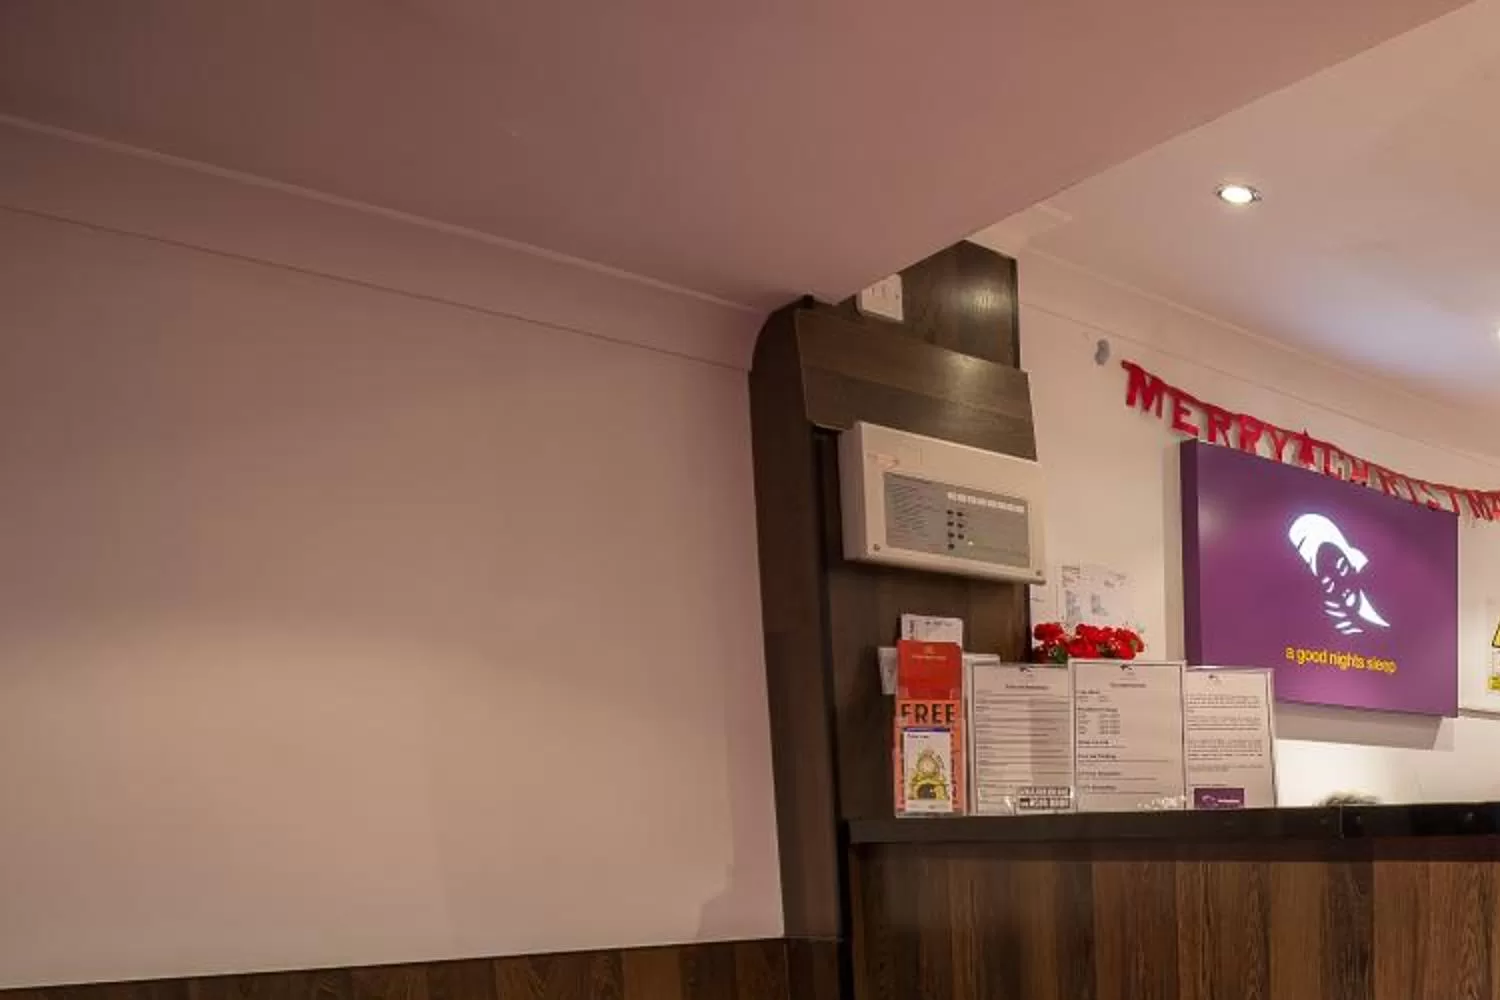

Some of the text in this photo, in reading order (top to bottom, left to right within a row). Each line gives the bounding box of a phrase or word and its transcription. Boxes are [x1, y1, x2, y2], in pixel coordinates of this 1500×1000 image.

[1121, 360, 1291, 463] MERRY
[1285, 647, 1398, 674] a good nights sleep
[900, 703, 956, 725] FREE
